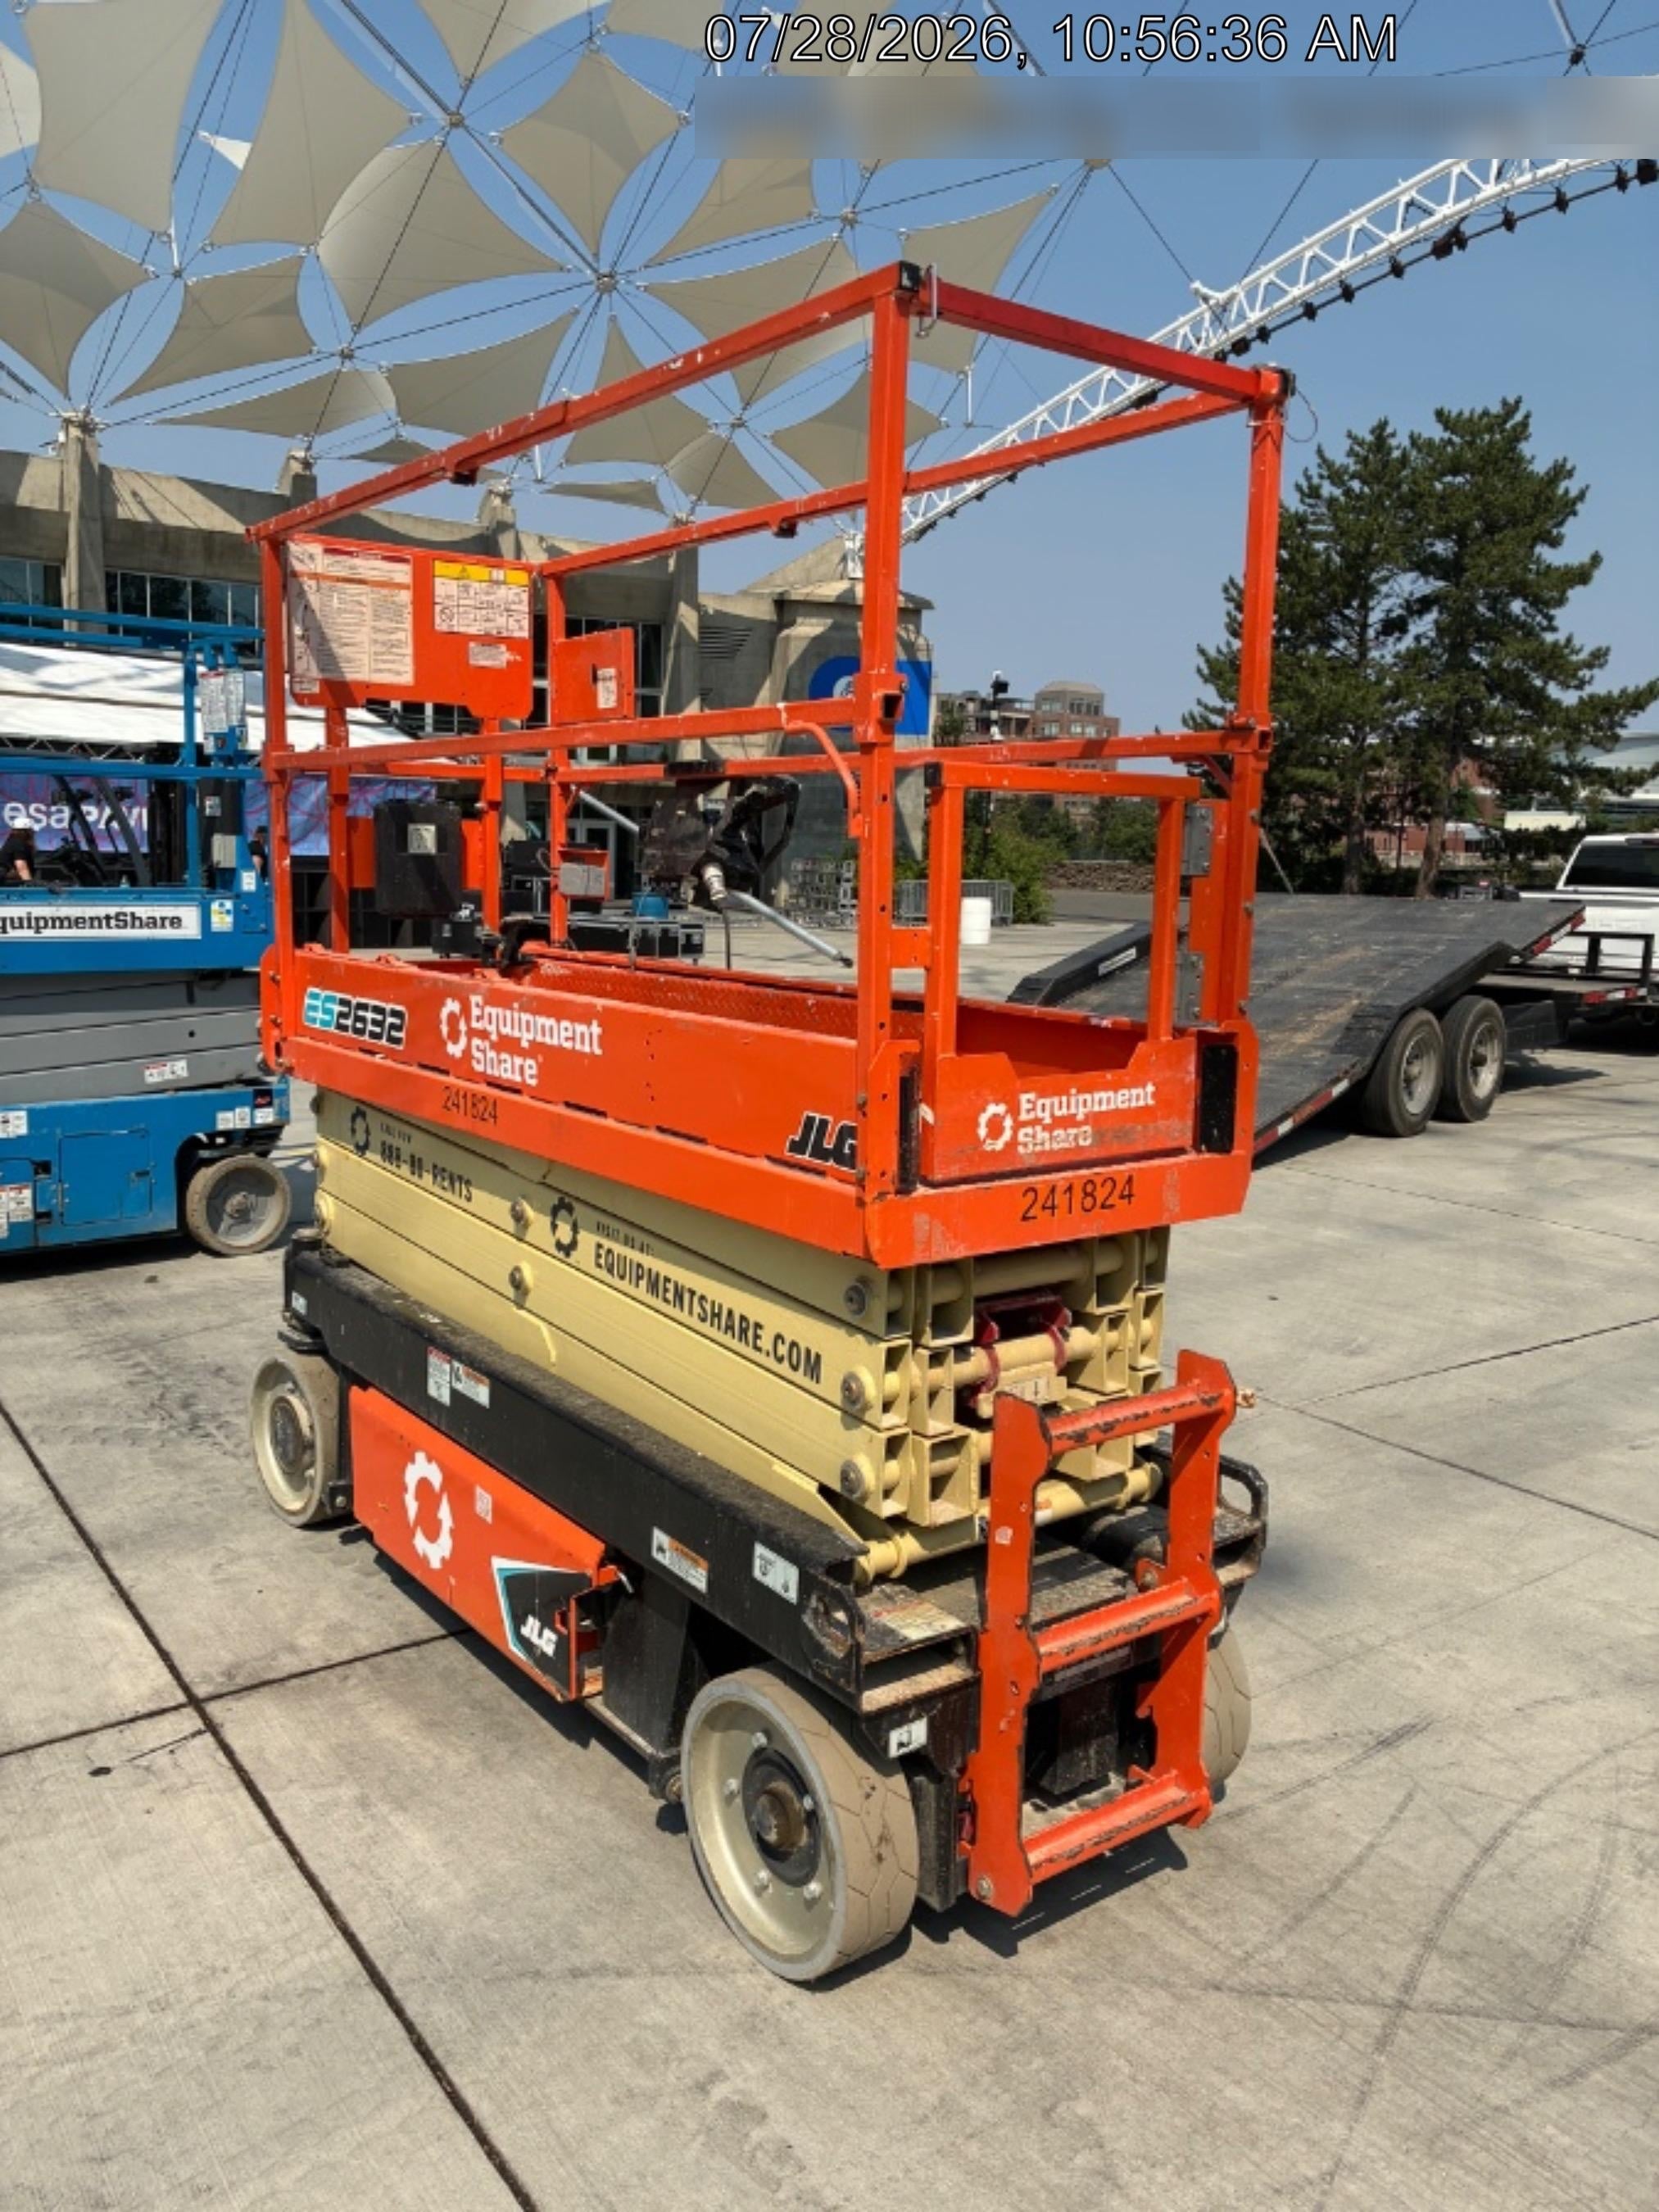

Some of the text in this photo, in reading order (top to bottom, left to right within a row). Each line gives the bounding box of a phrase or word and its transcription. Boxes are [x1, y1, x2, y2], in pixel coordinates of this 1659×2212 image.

[303, 987, 407, 1050] ES2632
[469, 995, 603, 1055] Equipment
[469, 1038, 539, 1086] Share
[441, 1085, 498, 1125] 241824
[1018, 1081, 1157, 1124] Equipment
[786, 1111, 858, 1172] JLG
[1017, 1125, 1092, 1154] Share
[1021, 1174, 1136, 1222] 241824
[593, 1241, 823, 1385] EQUIPMENTSHARE.COM
[520, 1613, 558, 1659] JLG
